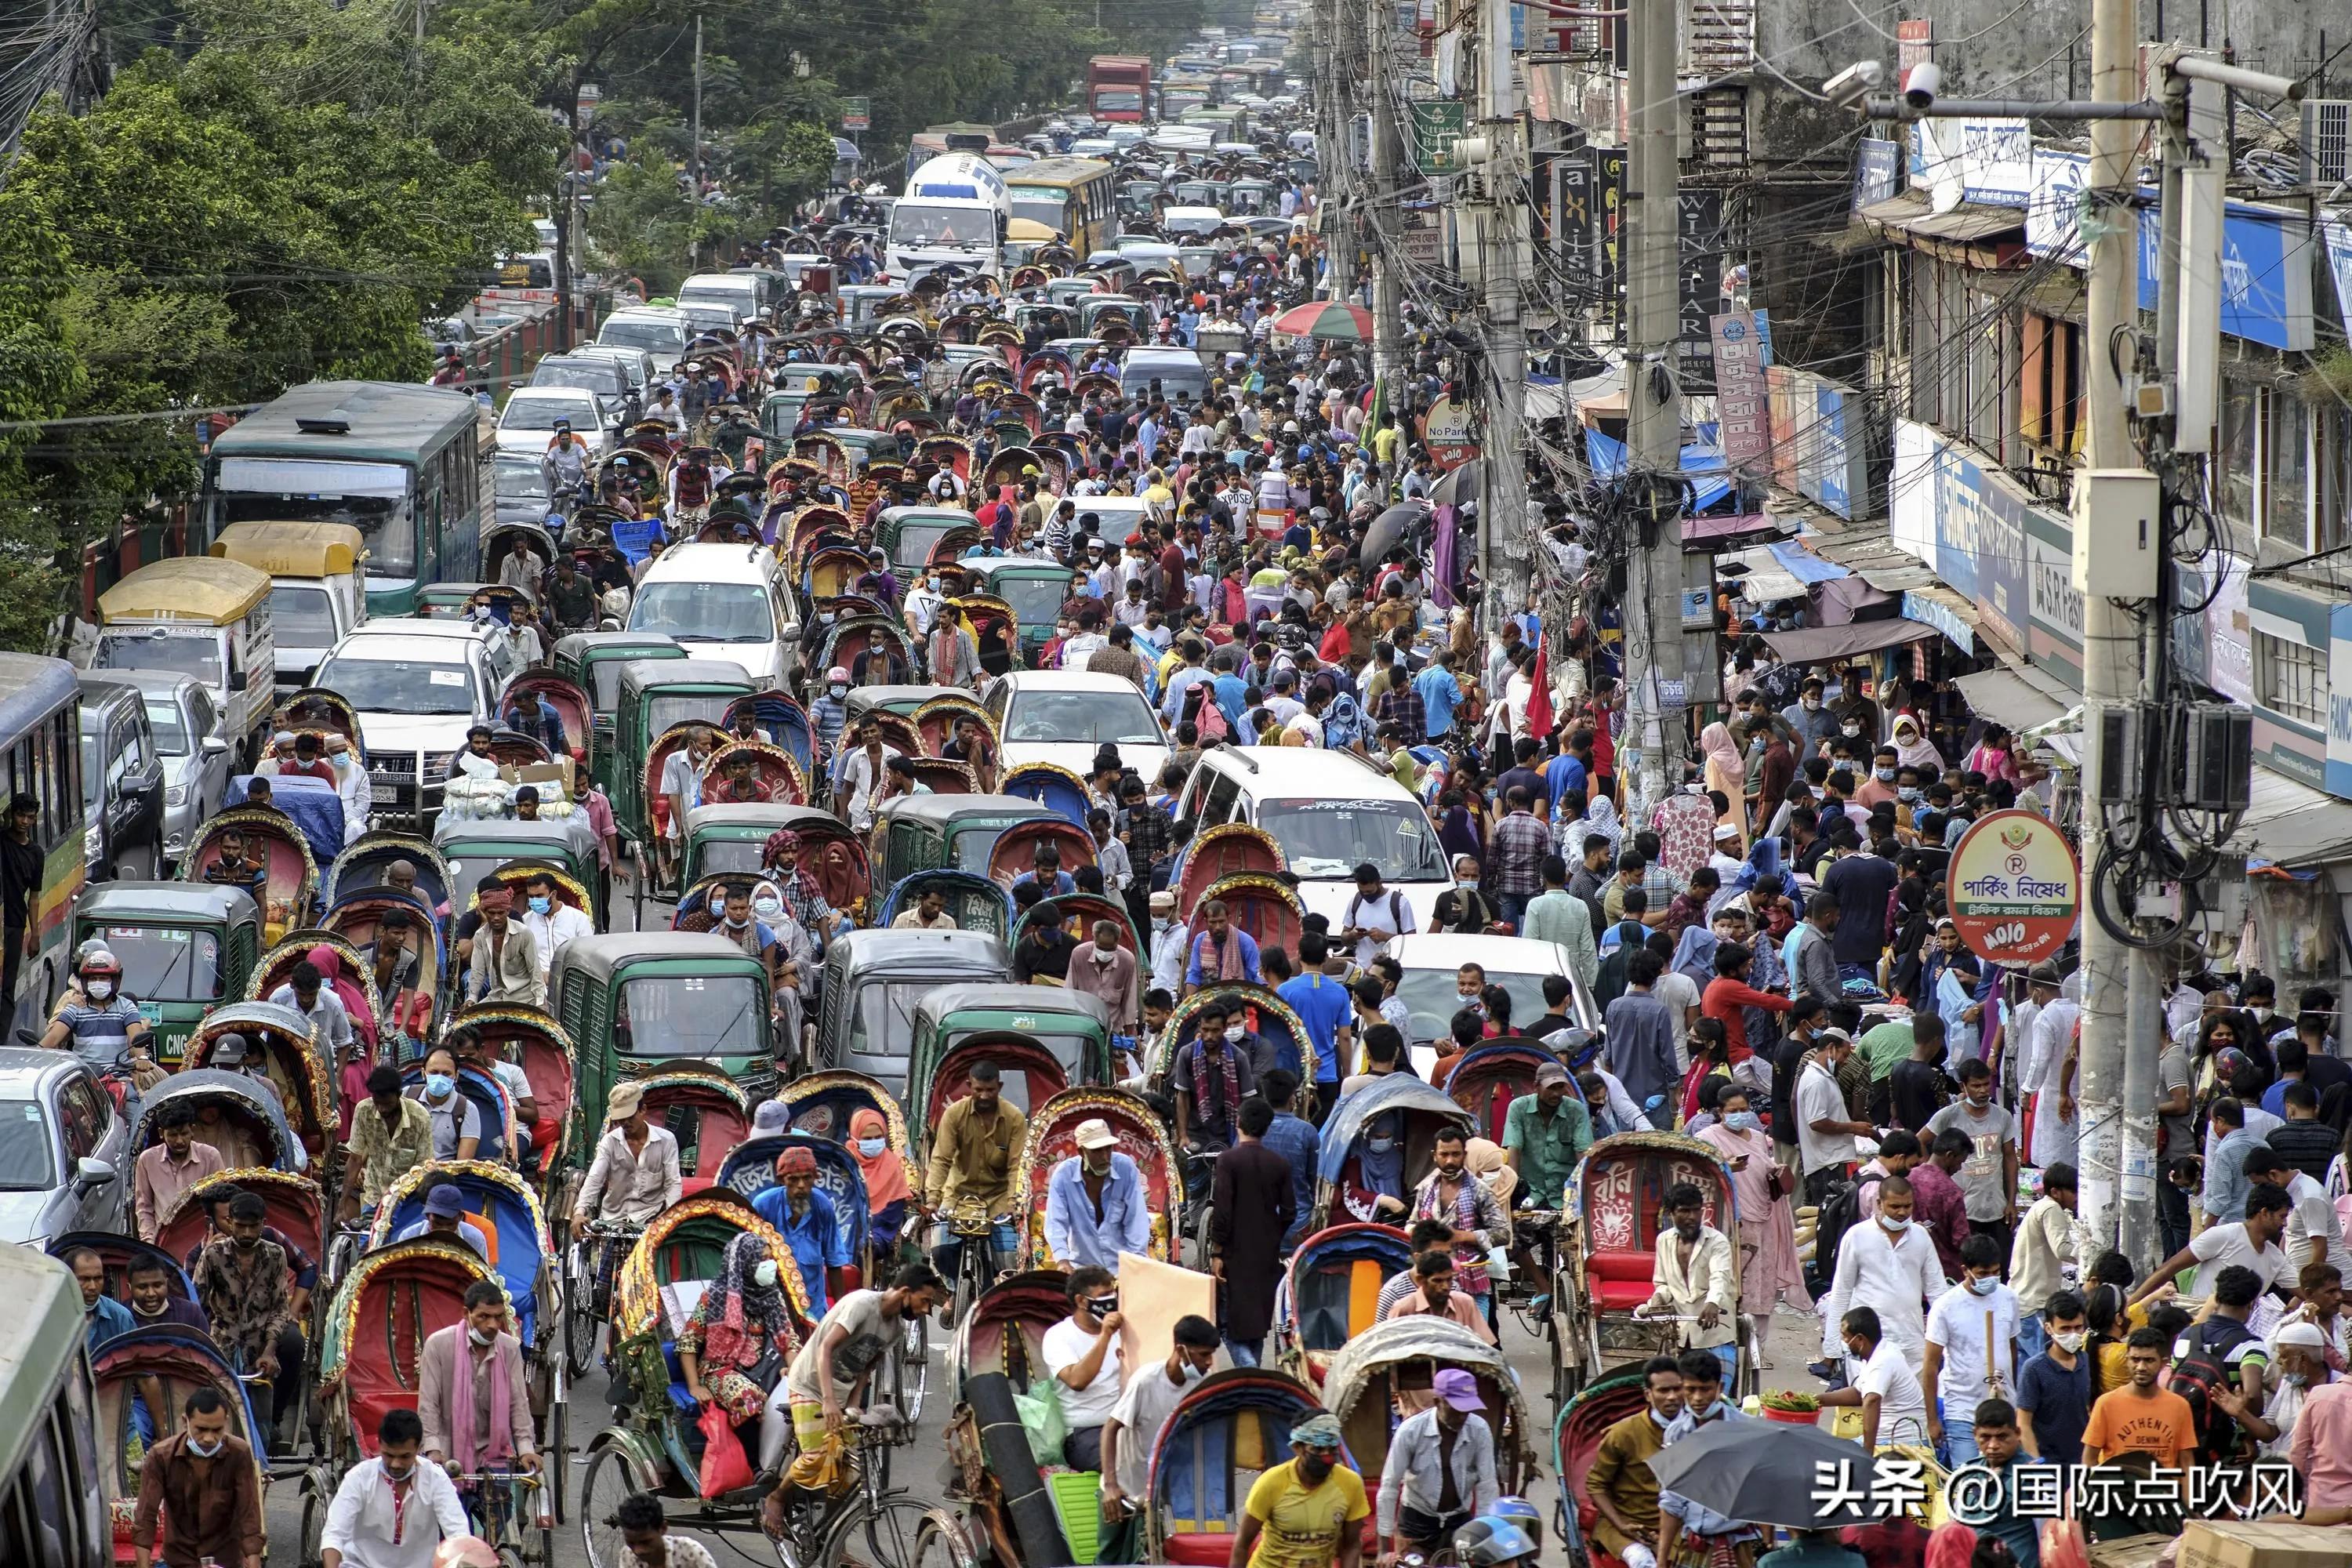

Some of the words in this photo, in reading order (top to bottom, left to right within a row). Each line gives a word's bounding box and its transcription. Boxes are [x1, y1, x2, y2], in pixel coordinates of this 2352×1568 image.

[1421, 125, 1458, 134] Uttara
[1423, 137, 1454, 147] Bank
[1422, 234, 1438, 243] ঘোষ
[1429, 427, 1443, 436] No
[1445, 427, 1479, 436] Parkn
[1441, 448, 1462, 463] MOJO
[2045, 566, 2062, 617] S.R
[2062, 575, 2085, 634] Fash
[369, 773, 410, 782] SUBISHI
[1962, 875, 2009, 899] পার্কিং
[2016, 876, 2067, 898] নিষেধ
[1968, 905, 2000, 916] ট্রাফিক
[2002, 906, 2030, 916] রমনা
[2031, 905, 2061, 916] বিভাগ
[1983, 922, 2027, 950] MOJO
[166, 1033, 187, 1054] CNG
[816, 1163, 848, 1196] ভাই
[2136, 1436, 2160, 1445] DENIM
